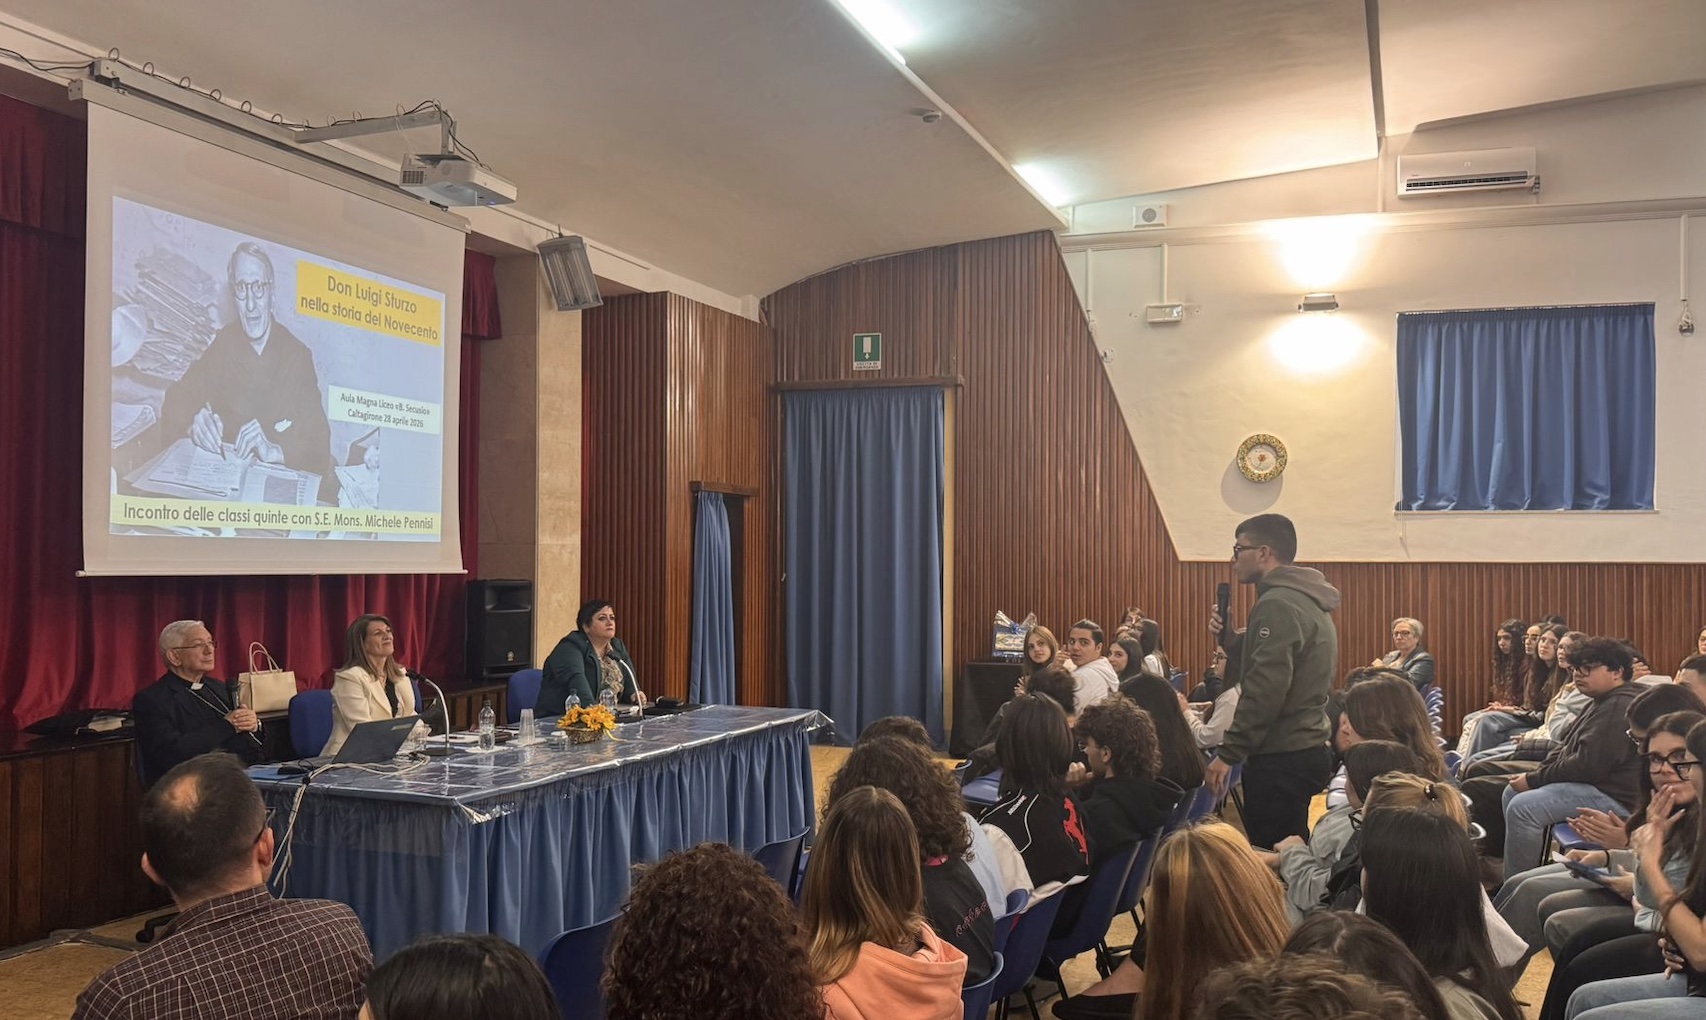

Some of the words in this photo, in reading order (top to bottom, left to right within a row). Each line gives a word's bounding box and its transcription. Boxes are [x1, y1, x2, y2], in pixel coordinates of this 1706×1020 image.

[327, 275, 352, 297] Don
[356, 283, 382, 307] Luigi
[385, 291, 417, 314] Sturzo
[300, 296, 329, 313] nella
[332, 302, 361, 321] storia
[365, 310, 381, 327] del
[384, 315, 438, 340] Novecento
[340, 393, 355, 403] Aula
[356, 395, 378, 408] Magna
[378, 399, 394, 410] Liceo
[347, 408, 383, 422] Caltagirone
[383, 414, 391, 423] 28
[392, 415, 409, 426] aprile
[409, 418, 424, 428] 2026
[124, 502, 179, 520] Incontro
[183, 506, 214, 522] delle
[218, 508, 250, 523] classi
[253, 510, 289, 526] quinte
[291, 513, 312, 526] con
[314, 512, 331, 526] S.E.
[334, 513, 363, 527] Mons.
[365, 514, 402, 528] Michele
[404, 516, 434, 530] Pennisi
